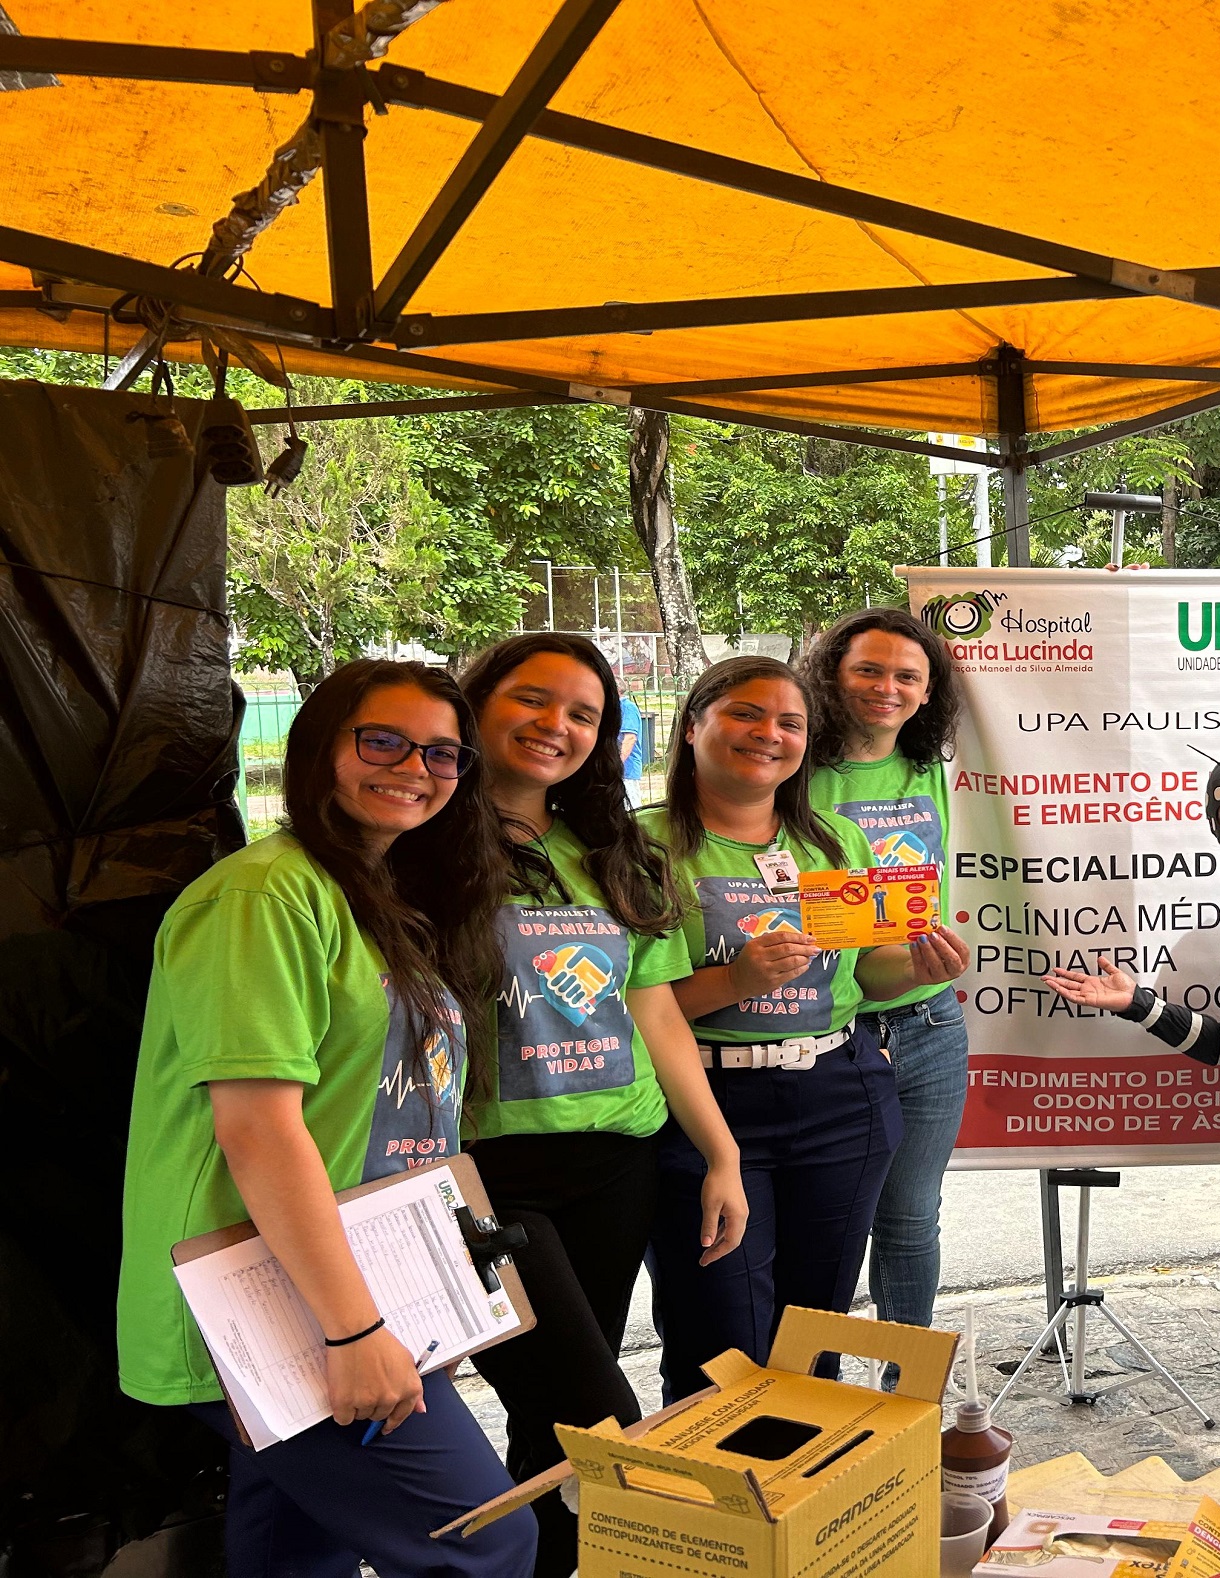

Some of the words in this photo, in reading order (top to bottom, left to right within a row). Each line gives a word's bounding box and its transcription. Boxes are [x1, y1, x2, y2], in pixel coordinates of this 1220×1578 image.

[1000, 608, 1092, 638] Hospital
[1002, 639, 1093, 661] Lucinda
[952, 664, 977, 674] ação
[979, 664, 1013, 673] Manoel
[1015, 664, 1027, 673] da
[1030, 663, 1052, 673] Silva
[1054, 663, 1093, 673] Almeida
[1018, 712, 1090, 732] UPA
[954, 770, 1151, 796] ATENDIMENTO
[1161, 771, 1198, 792] DE
[858, 811, 933, 829] UPANIZAR
[1013, 805, 1031, 826] E
[1041, 796, 1203, 825] EMERGÊNC
[724, 892, 800, 904] UPANIZ
[545, 909, 598, 917] PAULISTA
[977, 902, 1127, 936] CLÍNICA
[517, 922, 621, 936] UPANIZAR
[762, 986, 818, 1001] EGER
[738, 1001, 800, 1015] VIDAS
[521, 1036, 620, 1061] PROTEGER
[546, 1055, 605, 1075] VIDAS
[967, 1070, 1147, 1088] TENDIMENTO
[1156, 1069, 1193, 1087] DE
[1006, 1115, 1115, 1133] DIURNO
[1124, 1115, 1161, 1131] DE
[1169, 1115, 1184, 1131] 7
[386, 1138, 447, 1156] PROT
[712, 1402, 735, 1417] COM
[734, 1378, 776, 1404] CUIDADO
[678, 1434, 706, 1451] NCION
[815, 1468, 906, 1546] GRANDESC
[590, 1511, 660, 1537] CONTENEDOR
[662, 1528, 677, 1540] DE
[680, 1533, 745, 1556] ELEMENTOS
[850, 1550, 856, 1559] O
[857, 1526, 887, 1554] DESCARTE
[887, 1503, 917, 1531] ADEQUADO
[859, 1556, 868, 1567] DA
[869, 1542, 887, 1559] LINHA
[886, 1515, 919, 1546] PONTILHADA
[588, 1523, 683, 1555] CORTOPUNZANTES
[687, 1547, 701, 1559] DE
[704, 1551, 749, 1570] CARTON
[1129, 1561, 1169, 1571] atex
